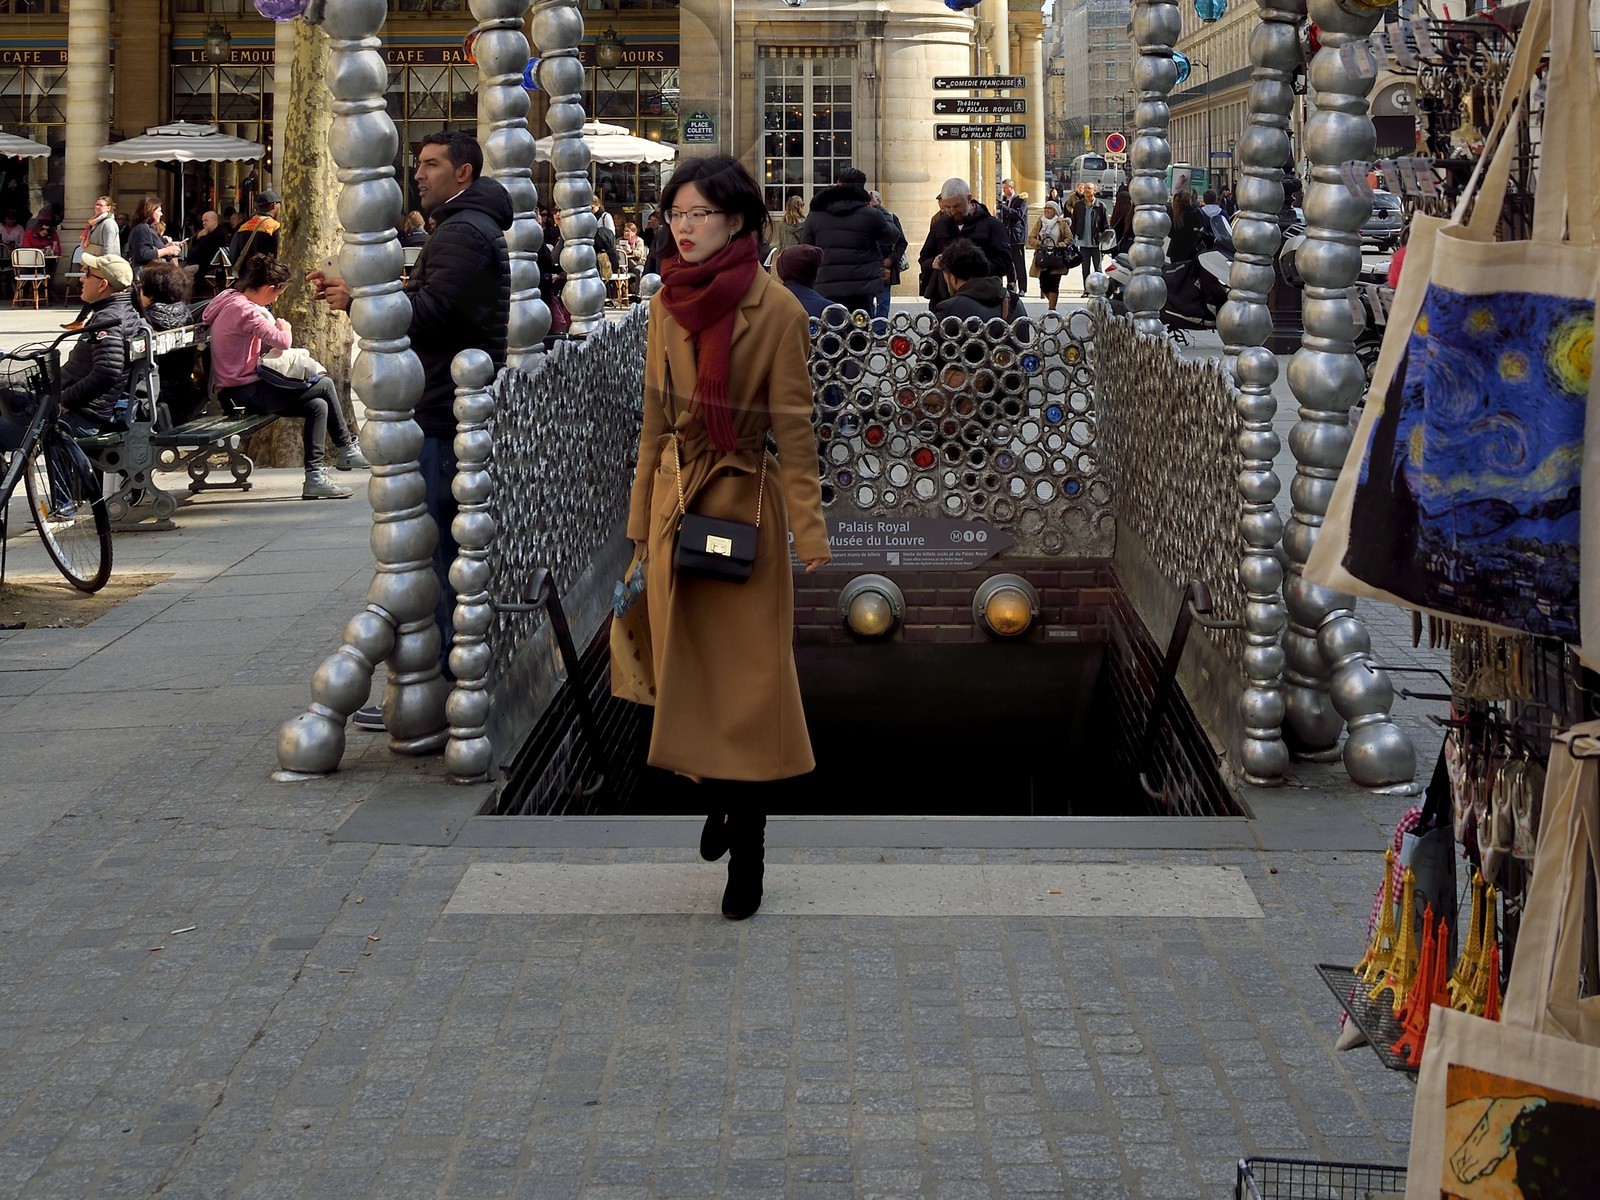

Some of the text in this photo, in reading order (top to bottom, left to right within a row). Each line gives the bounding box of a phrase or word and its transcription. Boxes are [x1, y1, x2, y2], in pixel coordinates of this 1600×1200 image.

[3, 51, 42, 62] CAFE
[191, 51, 275, 62] LE EMOU
[387, 50, 467, 62] CAFE BA
[838, 520, 910, 535] Palais Royal
[828, 534, 925, 547] Musée du Louvre
